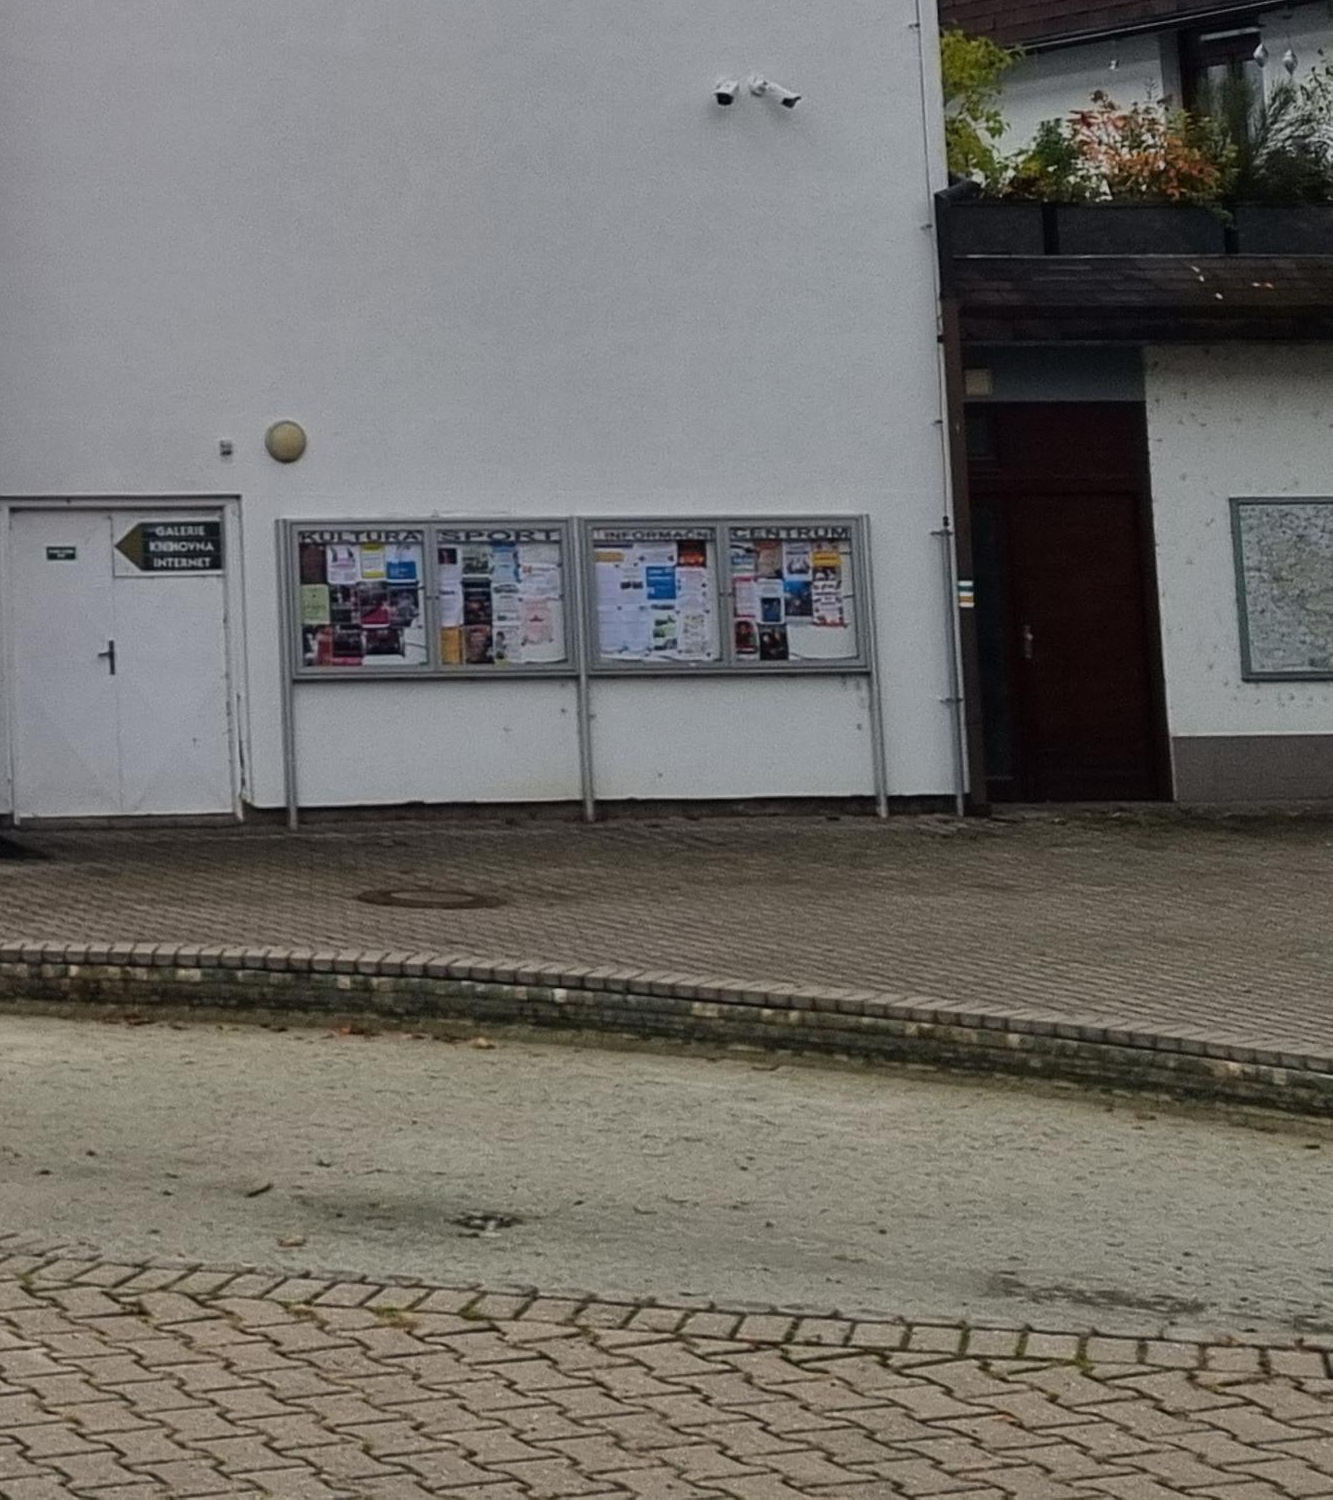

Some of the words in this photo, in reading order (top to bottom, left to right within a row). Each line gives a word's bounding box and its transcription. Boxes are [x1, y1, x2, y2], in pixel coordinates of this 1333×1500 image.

[155, 525, 206, 537] GALERIE
[301, 530, 420, 542] KULTURA
[438, 529, 561, 541] SPORT
[729, 527, 849, 539] CENTRUM
[148, 541, 215, 552] KNIHOVNA
[153, 557, 211, 568] INTERNET
